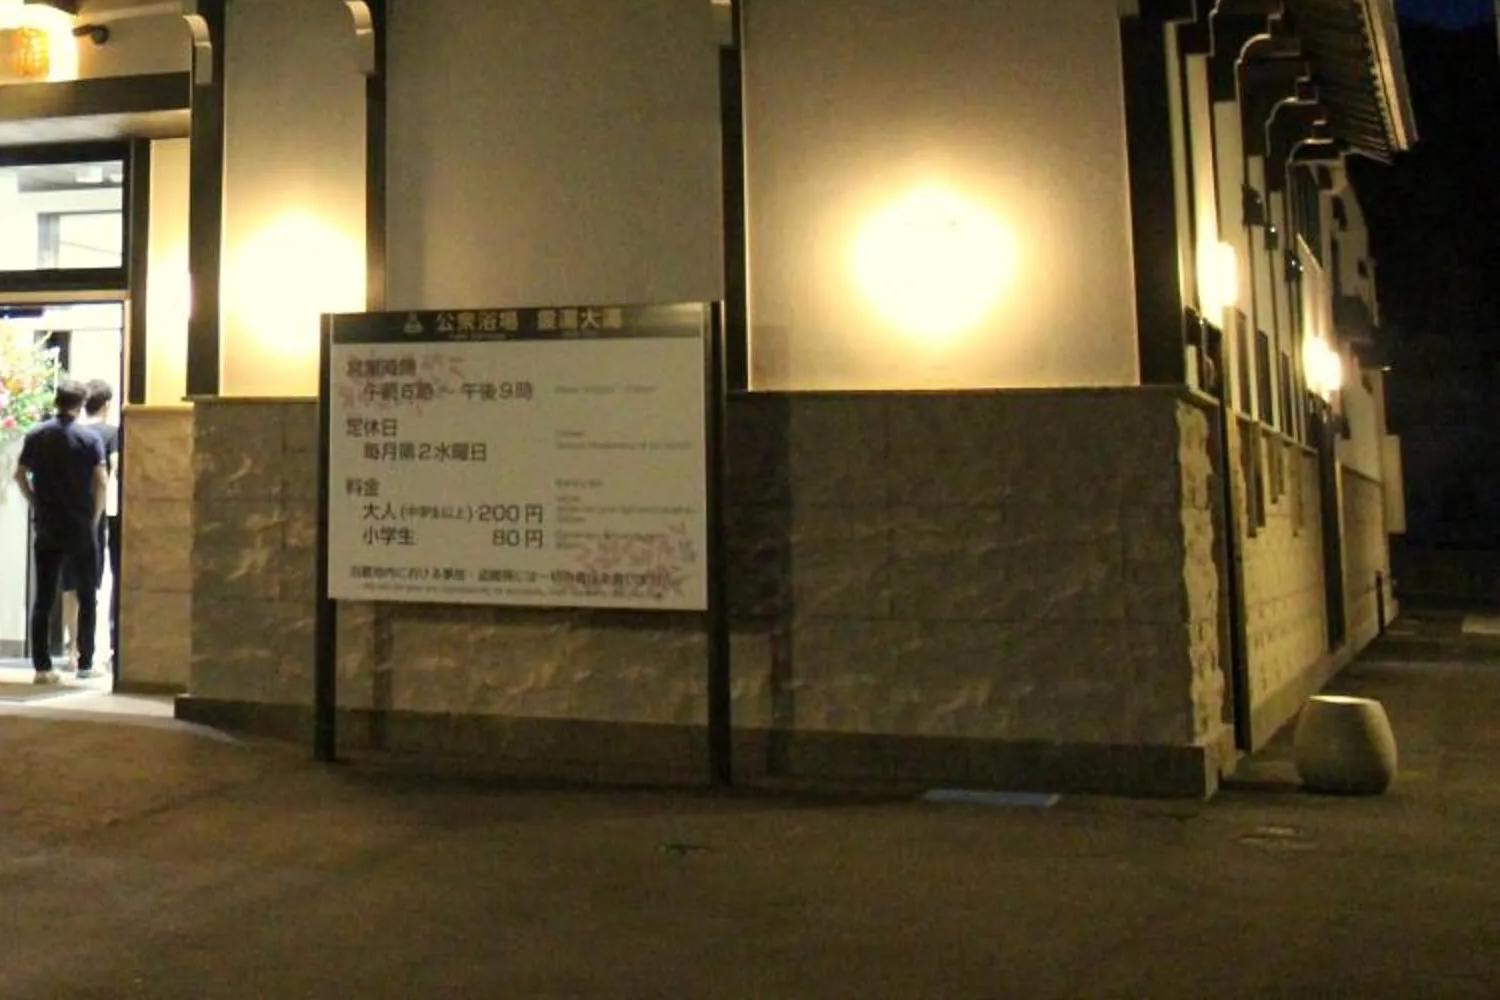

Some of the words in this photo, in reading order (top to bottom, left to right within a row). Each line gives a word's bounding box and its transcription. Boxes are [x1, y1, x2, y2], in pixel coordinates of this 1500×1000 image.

[346, 418, 398, 437] 定休日
[345, 477, 380, 497] 料金
[363, 526, 416, 546] 小学生
